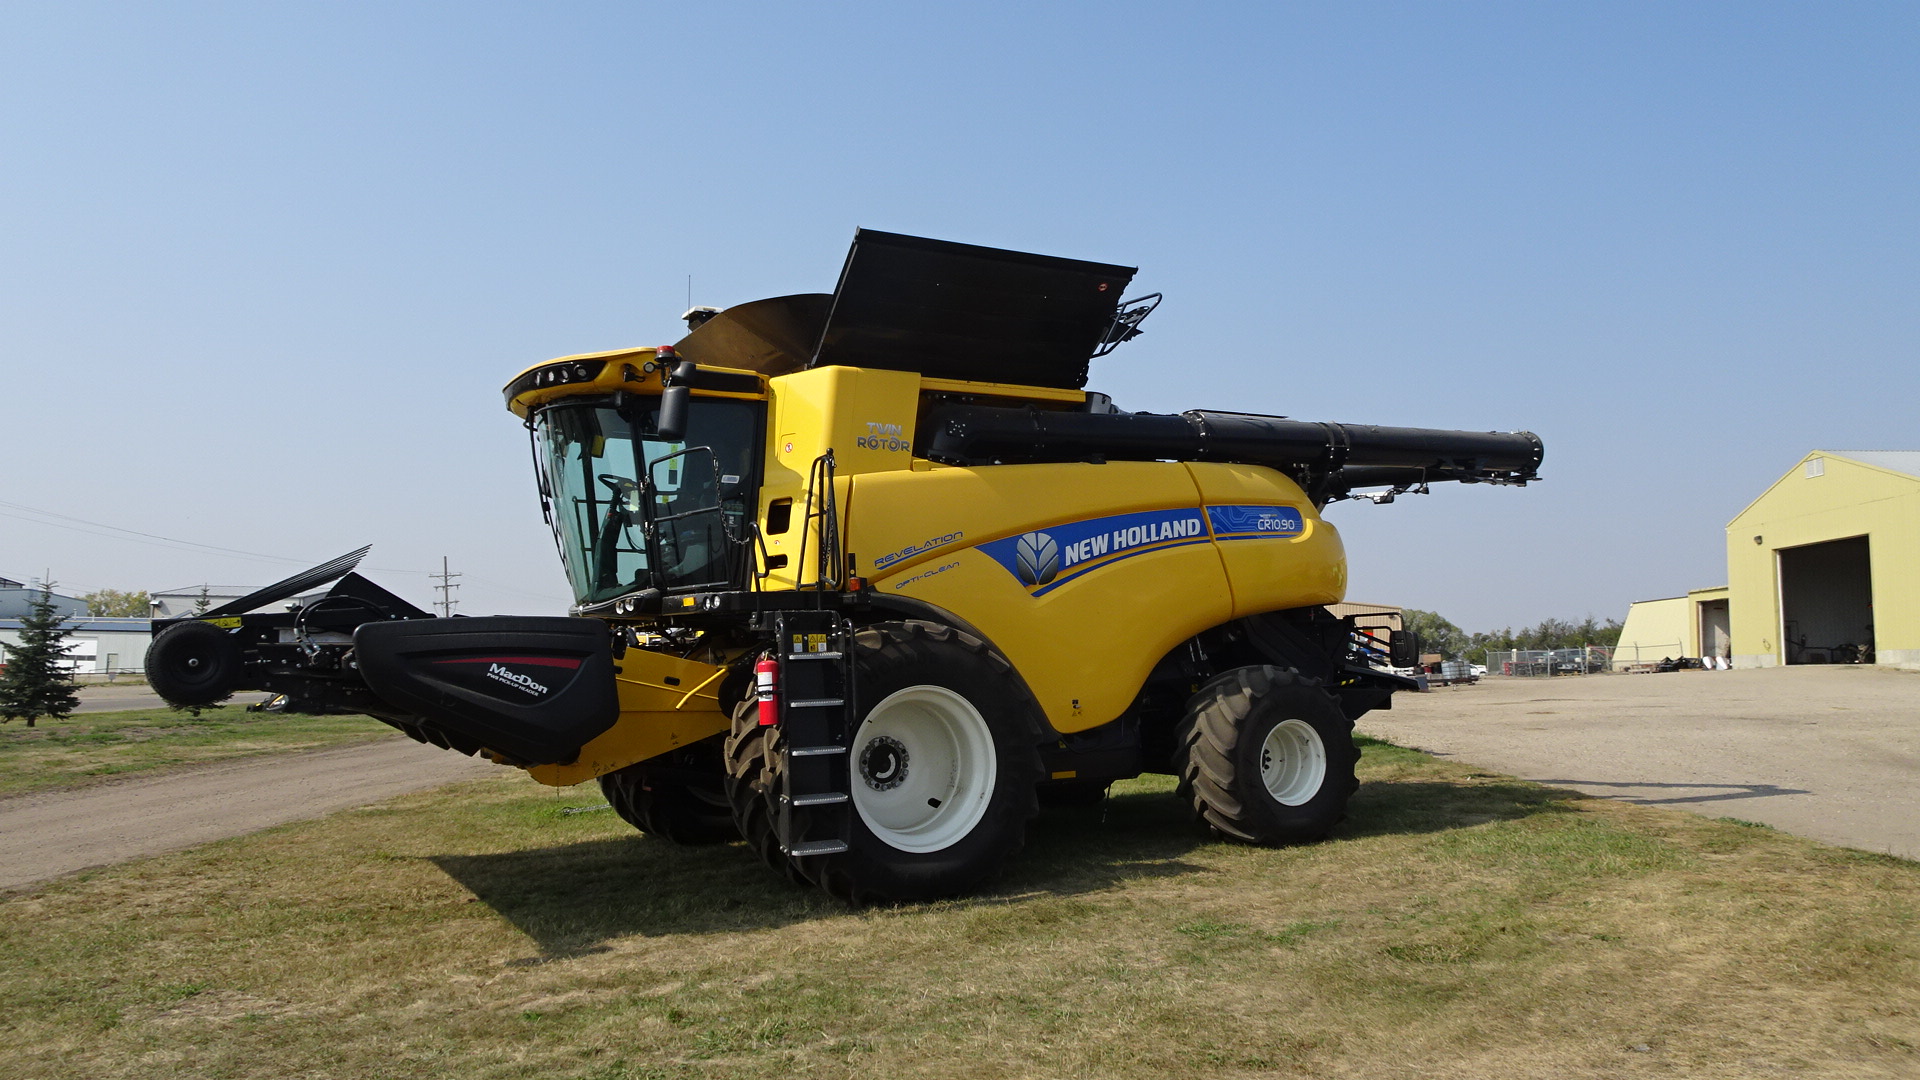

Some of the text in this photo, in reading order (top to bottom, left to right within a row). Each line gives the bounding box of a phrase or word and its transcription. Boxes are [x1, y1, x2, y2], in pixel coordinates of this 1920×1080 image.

[857, 434, 911, 452] ROTOR
[866, 422, 902, 436] TWIN
[874, 531, 963, 567] REVELATION
[1065, 518, 1201, 567] NEW HOLLAND
[895, 561, 960, 590] OPTI-CLEAN
[489, 662, 548, 693] MacDon
[518, 685, 539, 696] HEADER
